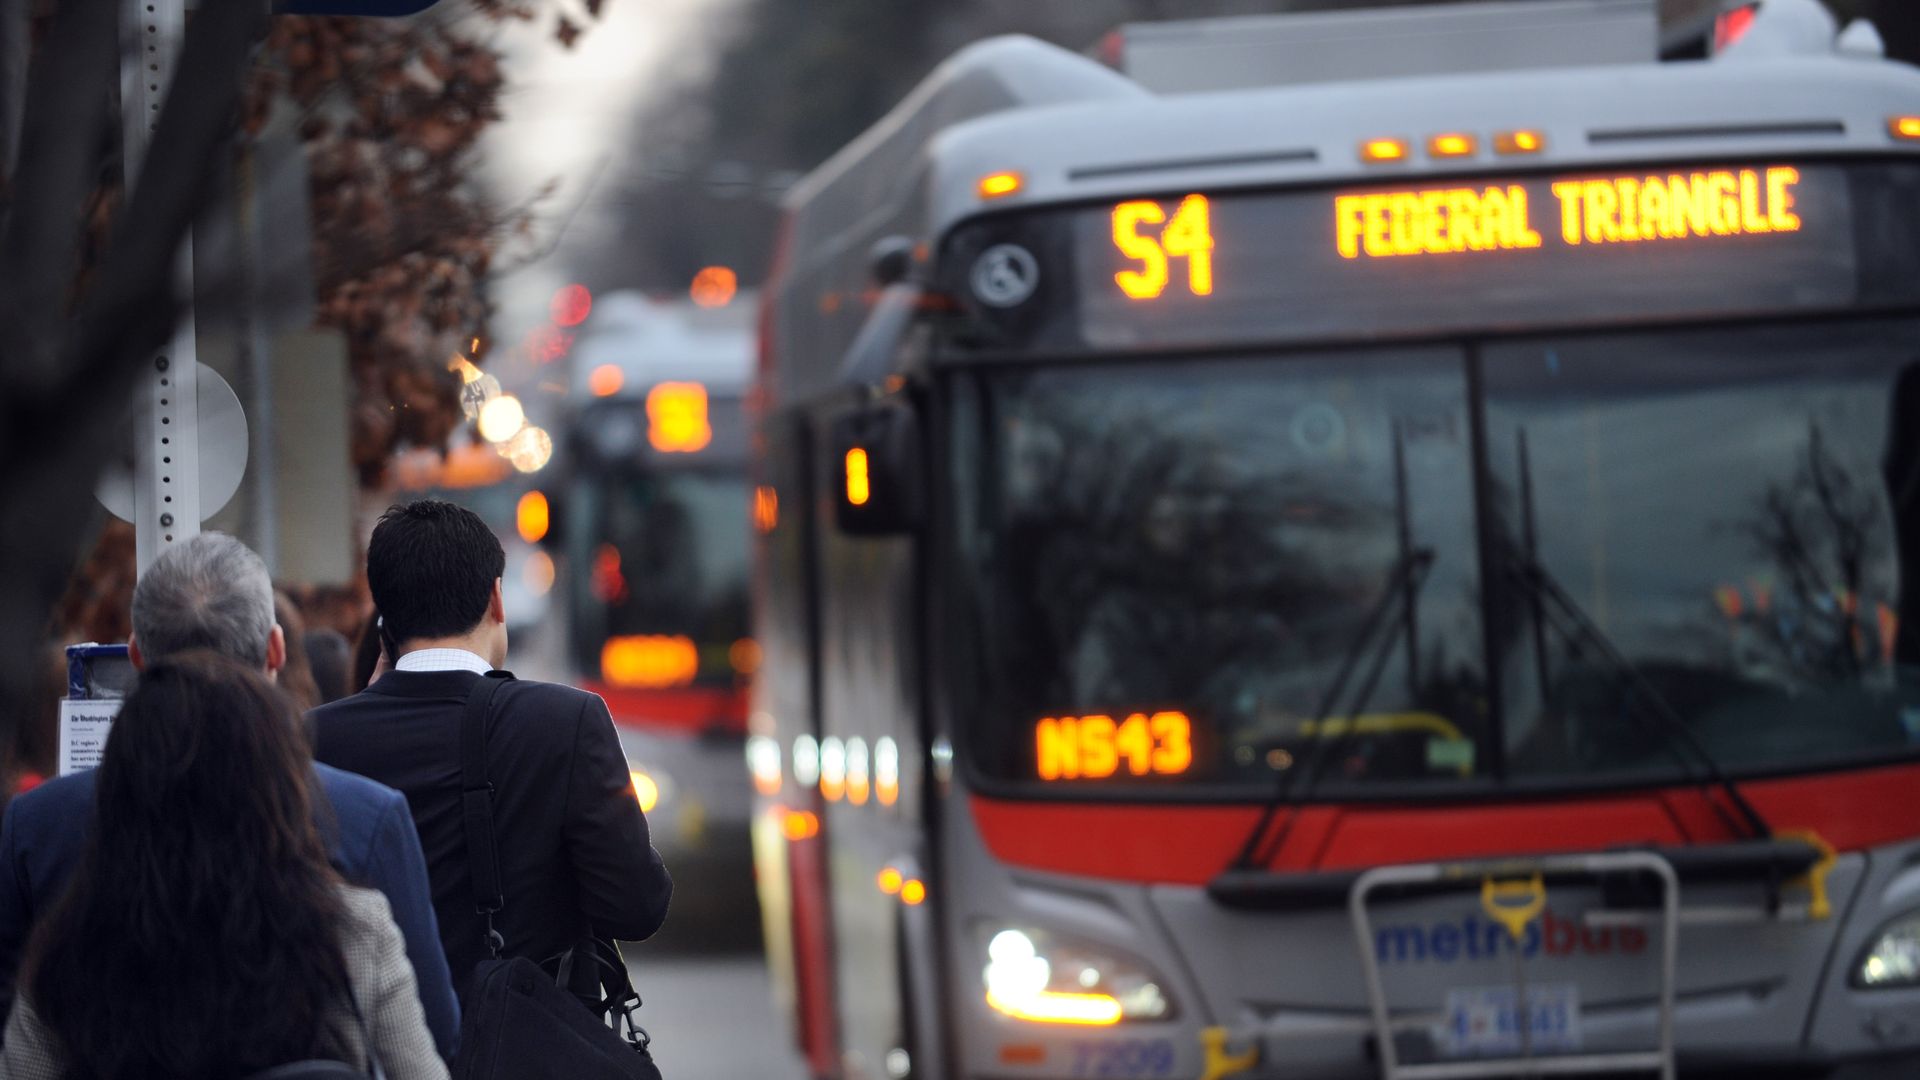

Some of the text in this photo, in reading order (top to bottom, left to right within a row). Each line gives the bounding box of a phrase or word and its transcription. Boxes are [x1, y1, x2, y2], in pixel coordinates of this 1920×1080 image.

[1111, 167, 1801, 299] S4 FEDERAL TRIANGLE
[1375, 907, 1648, 961] metrobus
